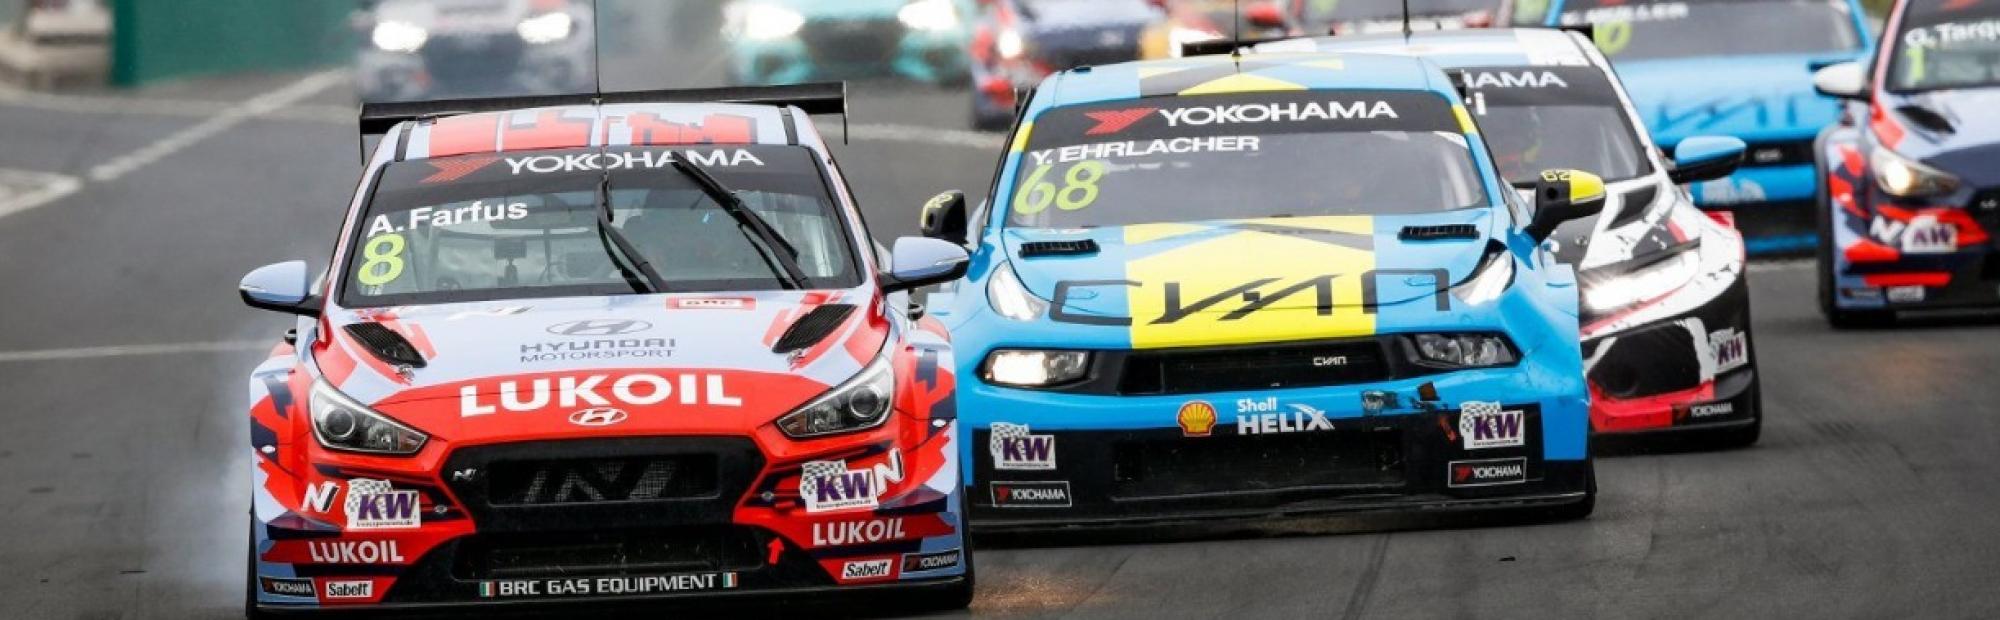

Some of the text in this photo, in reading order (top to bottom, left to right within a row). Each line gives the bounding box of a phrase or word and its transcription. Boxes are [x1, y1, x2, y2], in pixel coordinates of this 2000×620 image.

[1160, 101, 1397, 127] YOKOHAMA
[1060, 136, 1259, 161] EHRLACHER
[504, 149, 764, 175] YOKOHAMA
[1013, 161, 1102, 215] 68
[409, 201, 528, 230] Farfus
[358, 233, 405, 286] 8
[520, 338, 675, 353] HYUNDAI
[520, 349, 673, 363] MOTORSPORT
[460, 374, 742, 417] LUKOIL
[1237, 397, 1277, 412] Shell
[1237, 408, 1335, 435] HELIX
[1474, 413, 1522, 440] KW
[1002, 437, 1052, 461] KW
[1472, 465, 1522, 479] YOKOHAMA
[816, 471, 871, 502] KW
[1011, 488, 1066, 500] YOKOHAMA
[358, 493, 417, 520] KW
[813, 517, 905, 546] LUKOIL
[308, 540, 404, 563] LUKOIL
[845, 562, 888, 577] Sabelt
[328, 583, 369, 597] Sabelt
[499, 573, 718, 597] BRC GAS EQUIPMENT
